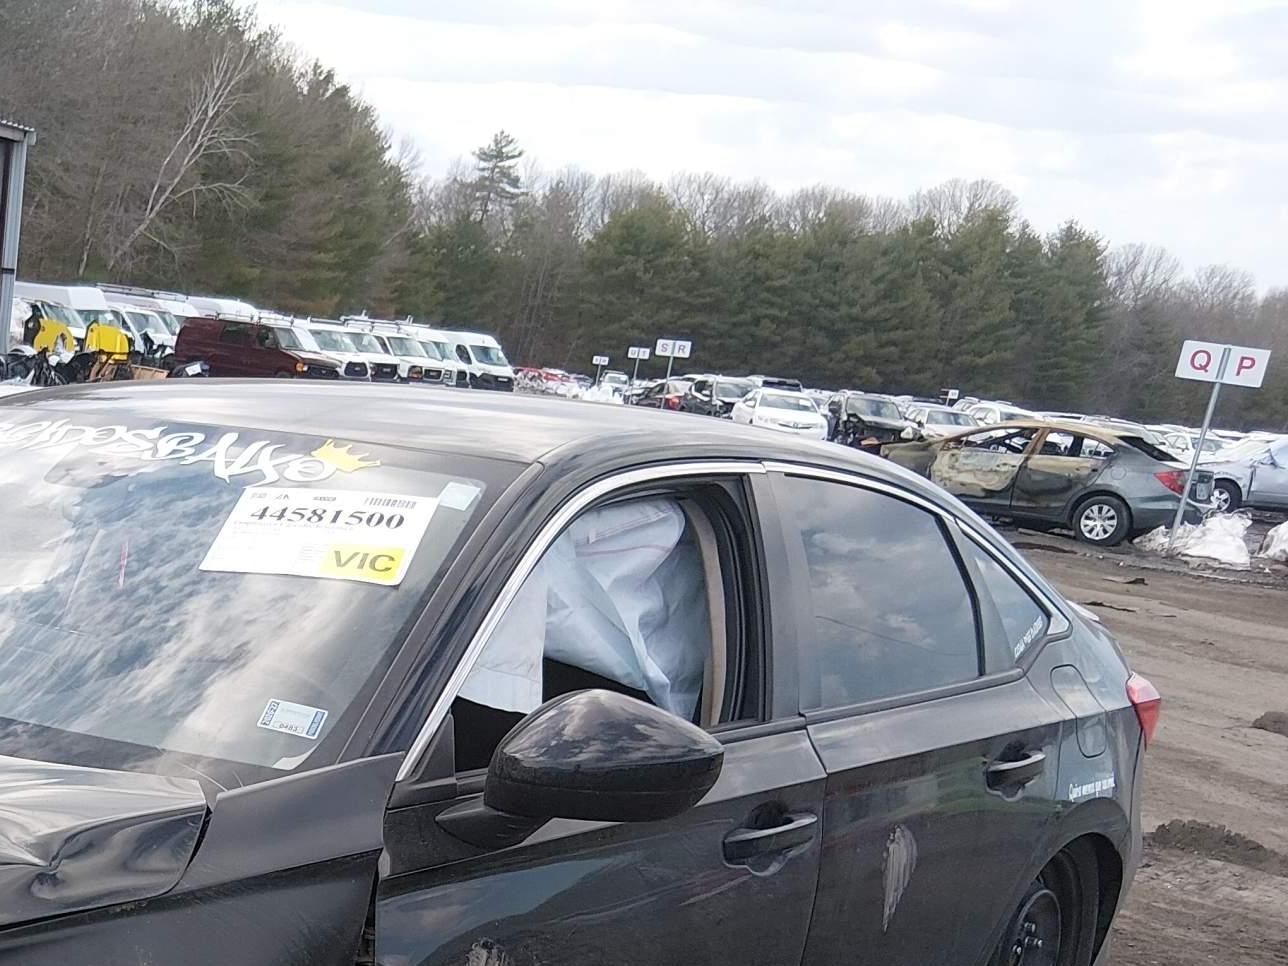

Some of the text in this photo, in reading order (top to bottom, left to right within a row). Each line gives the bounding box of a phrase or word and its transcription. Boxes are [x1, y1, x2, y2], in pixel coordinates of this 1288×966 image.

[660, 343, 686, 354] S R
[1190, 349, 1256, 377] Q P
[250, 505, 405, 530] 44581500
[333, 550, 396, 573] VIC
